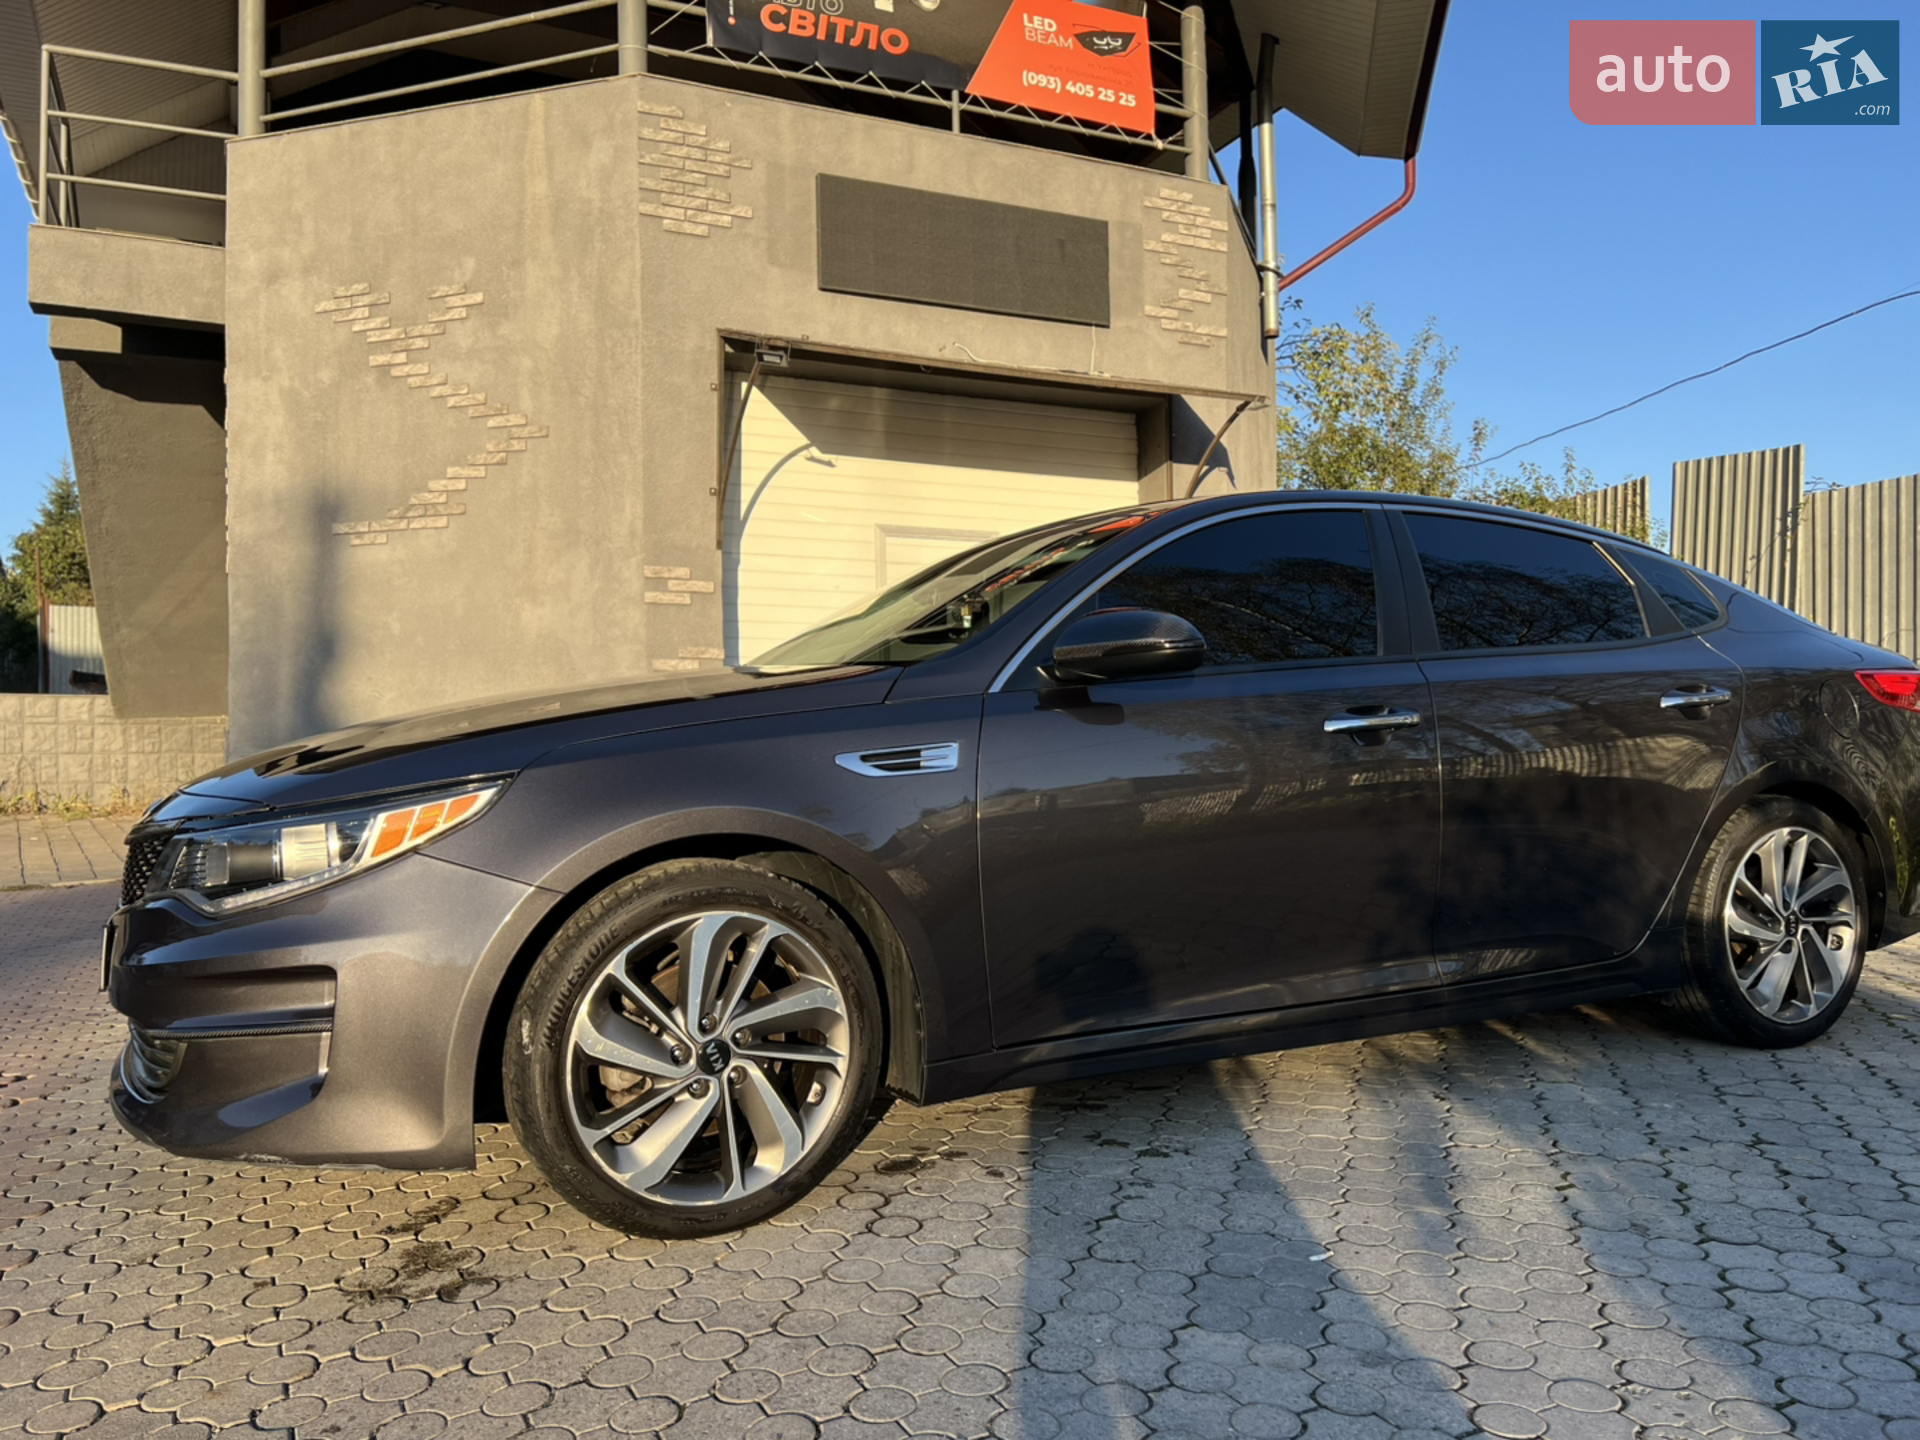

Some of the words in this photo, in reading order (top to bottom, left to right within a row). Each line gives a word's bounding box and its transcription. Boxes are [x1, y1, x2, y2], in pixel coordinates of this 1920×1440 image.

[760, 3, 910, 55] СВІТЛО
[1023, 13, 1057, 32] LED
[1025, 27, 1073, 50] BEAM
[1022, 69, 1062, 94] (093)
[1065, 81, 1094, 98] 405
[1097, 87, 1115, 102] 25
[1118, 92, 1136, 107] 25
[705, 1042, 725, 1072] KIA
